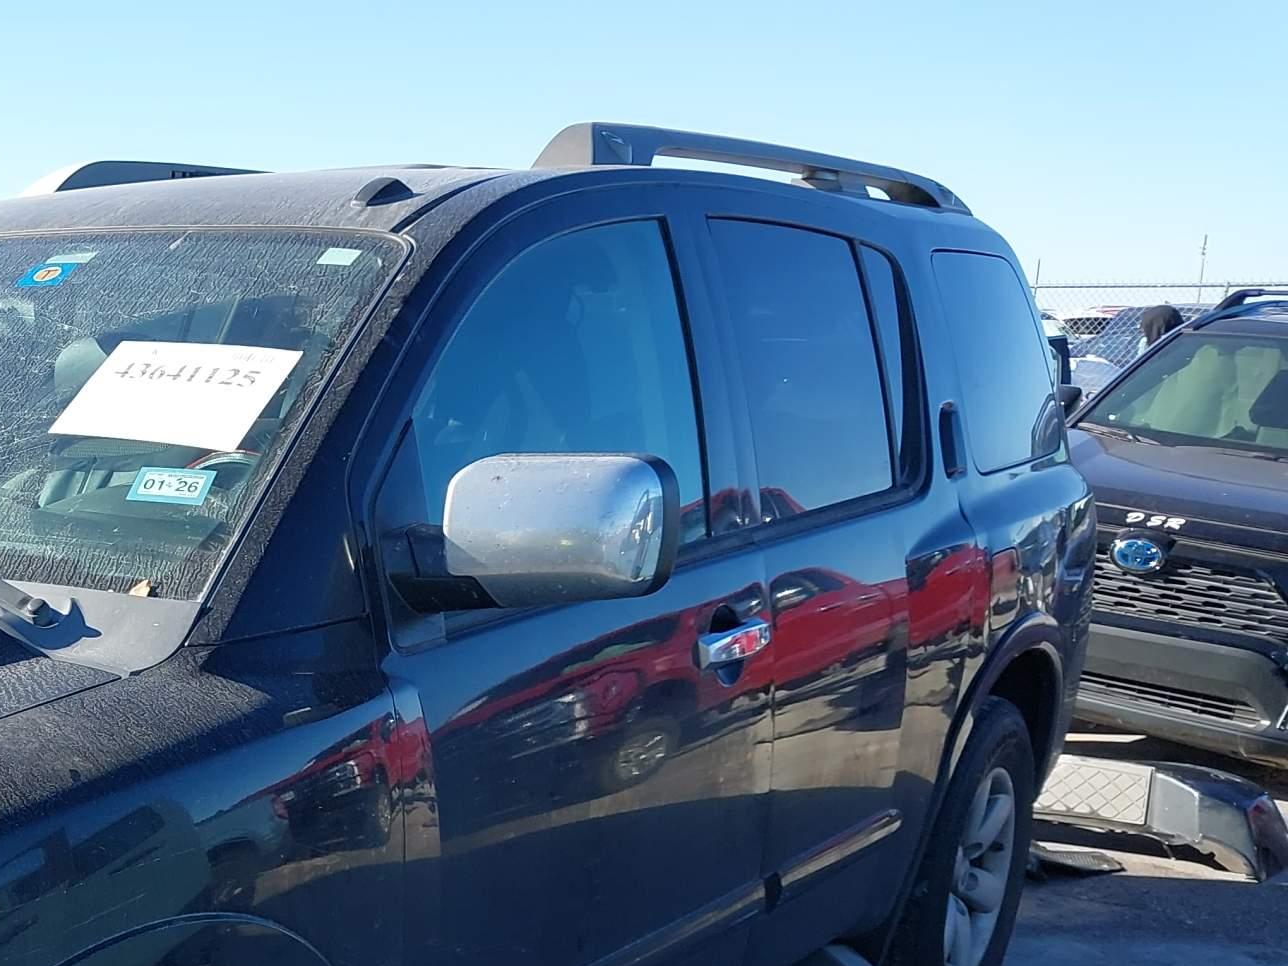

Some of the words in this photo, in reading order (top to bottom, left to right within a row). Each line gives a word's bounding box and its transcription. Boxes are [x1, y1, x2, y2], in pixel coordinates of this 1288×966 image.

[114, 362, 261, 387] 43641125
[143, 478, 166, 491] 01
[175, 480, 200, 493] 26
